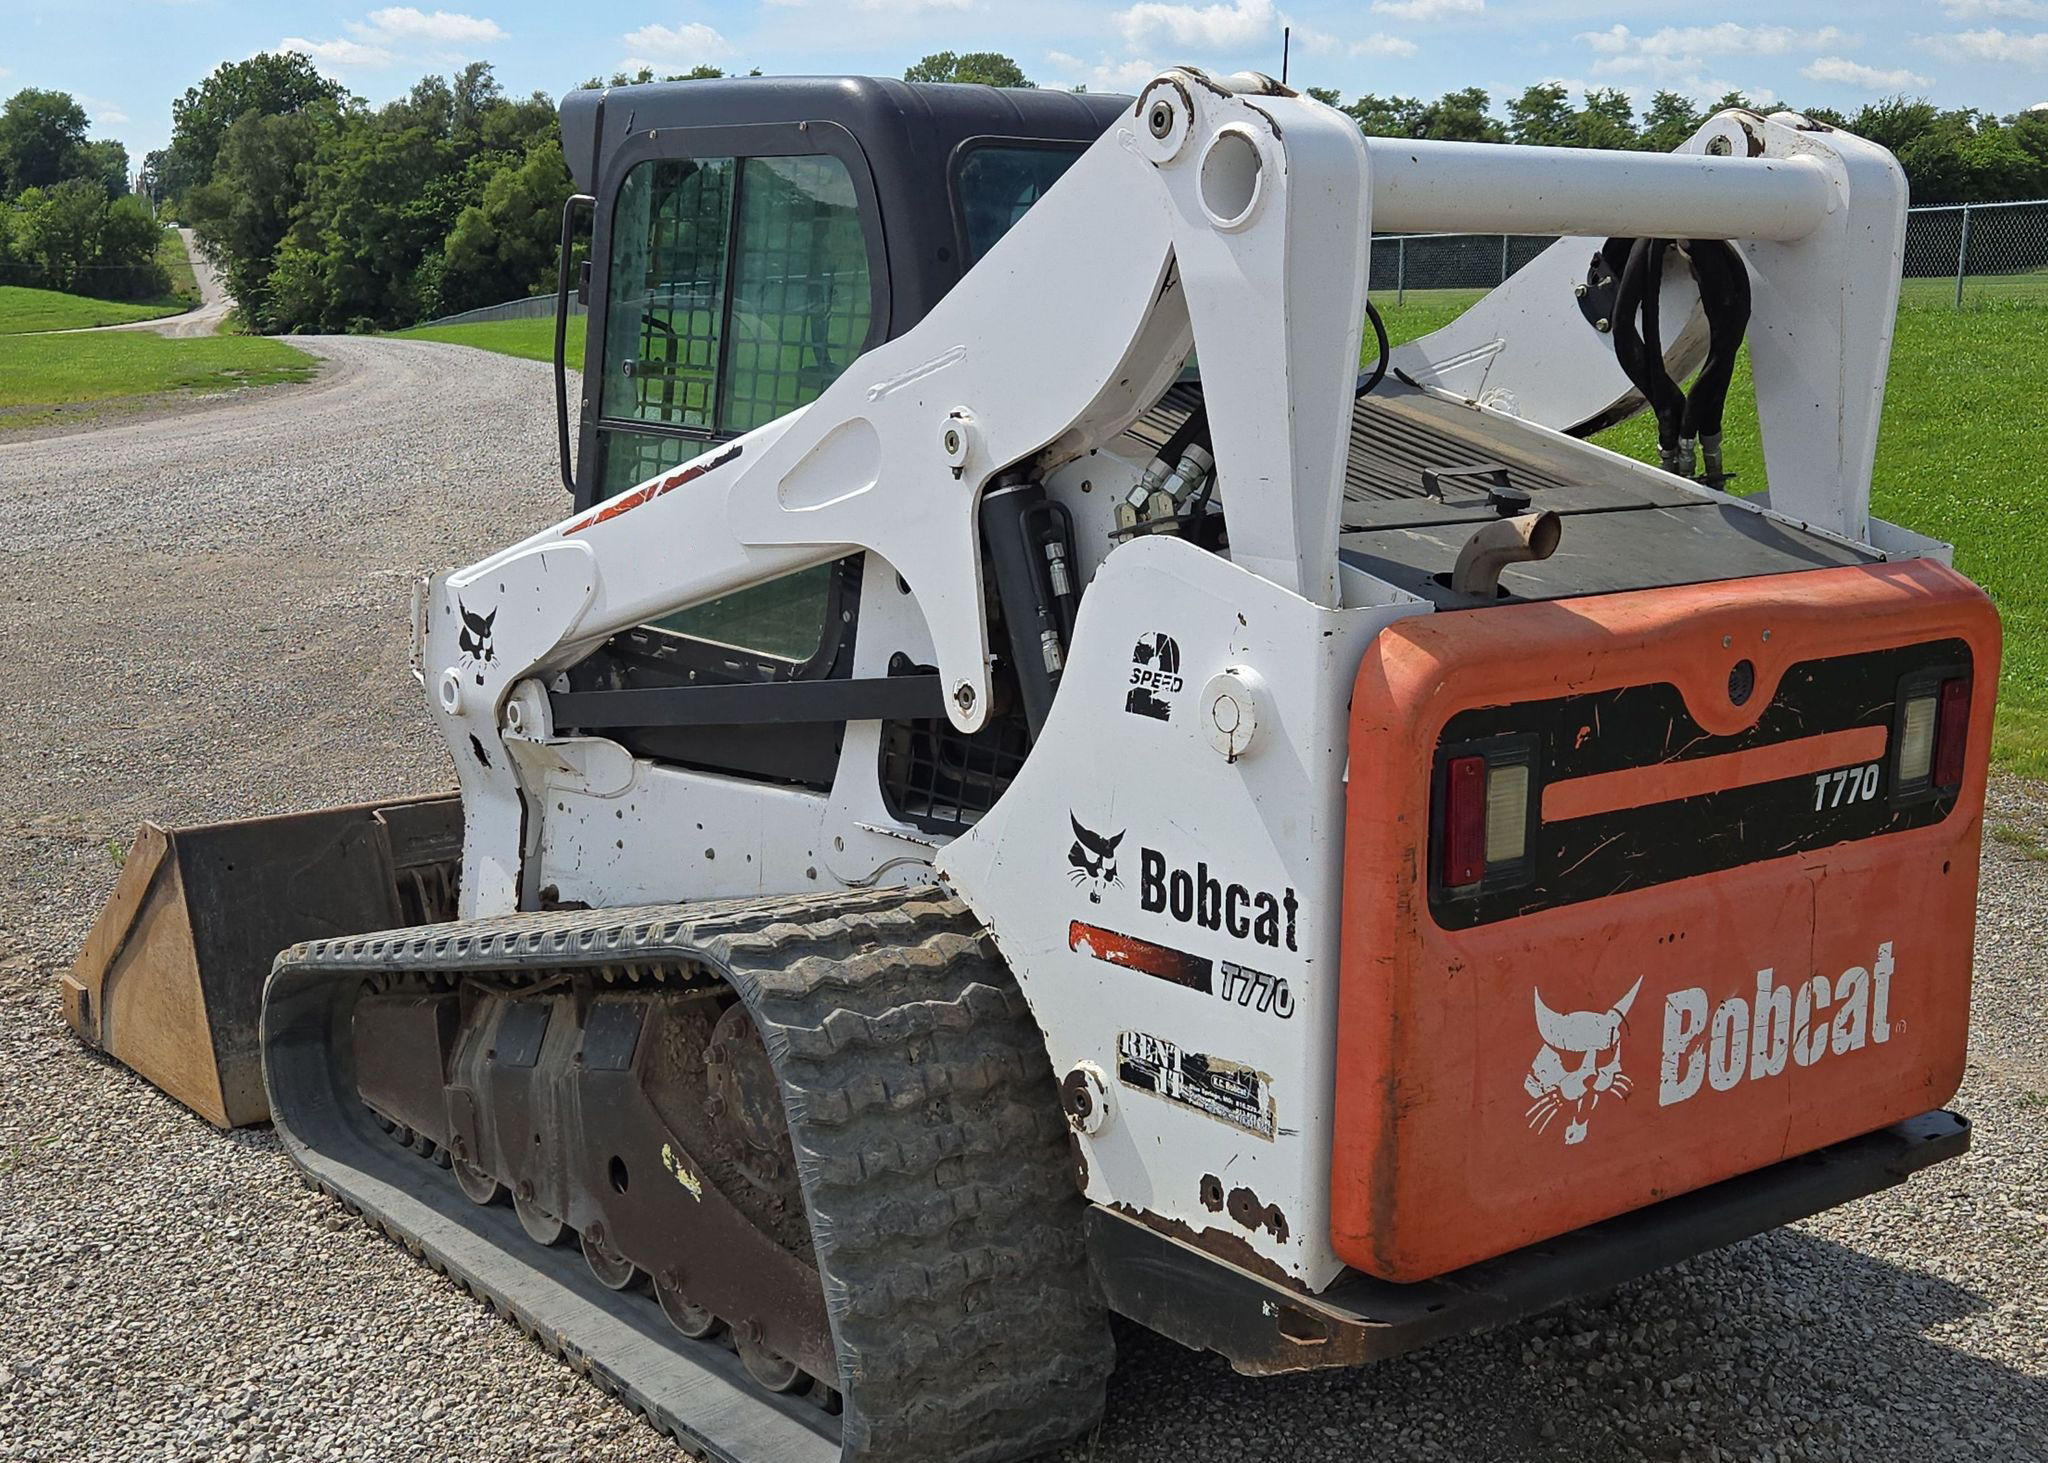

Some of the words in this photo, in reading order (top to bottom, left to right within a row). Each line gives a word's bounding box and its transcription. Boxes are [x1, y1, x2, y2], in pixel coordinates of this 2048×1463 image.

[1129, 668, 1183, 693] SPEED
[1815, 764, 1880, 811] T770
[1141, 847, 1299, 952] Bobcat
[1220, 960, 1295, 1019] T770
[1658, 941, 1895, 1107] Bobcat
